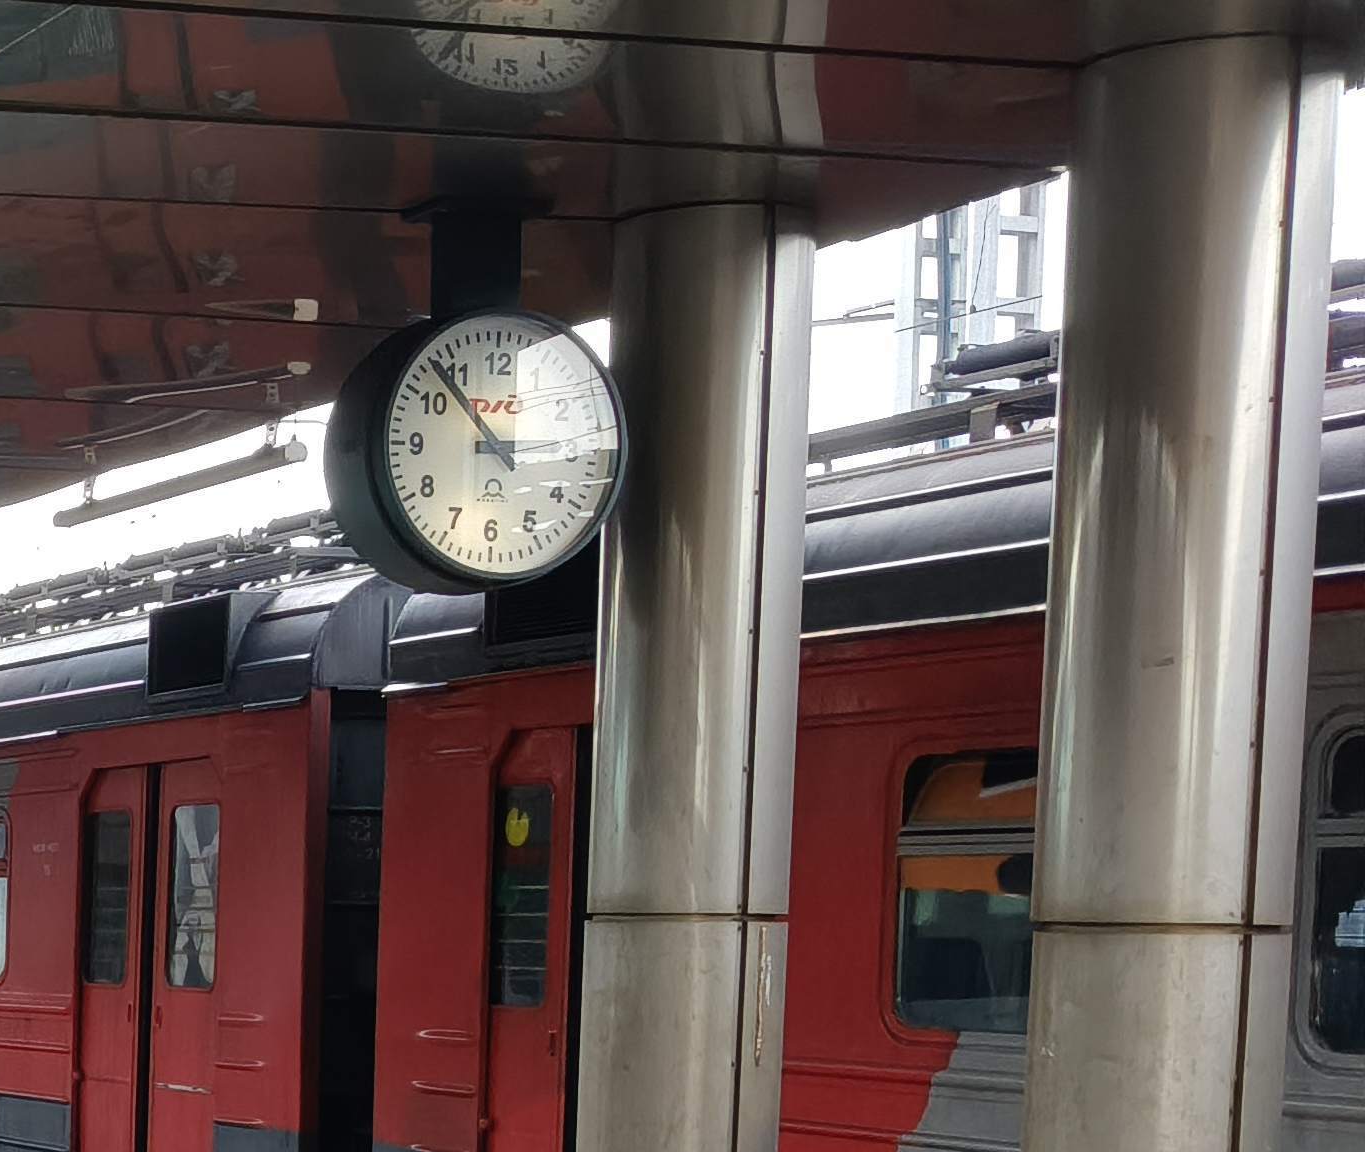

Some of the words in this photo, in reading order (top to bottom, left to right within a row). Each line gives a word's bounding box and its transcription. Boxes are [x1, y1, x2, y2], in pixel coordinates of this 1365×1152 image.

[446, 363, 469, 386] 11
[485, 352, 512, 376] 12
[530, 367, 540, 391] 1
[420, 391, 447, 415] 10
[555, 399, 569, 422] 2
[409, 432, 424, 455] 9
[420, 475, 435, 498] 8
[549, 484, 564, 504] 4
[448, 506, 462, 529] 7
[522, 510, 537, 532] 5
[483, 519, 498, 542] 6
